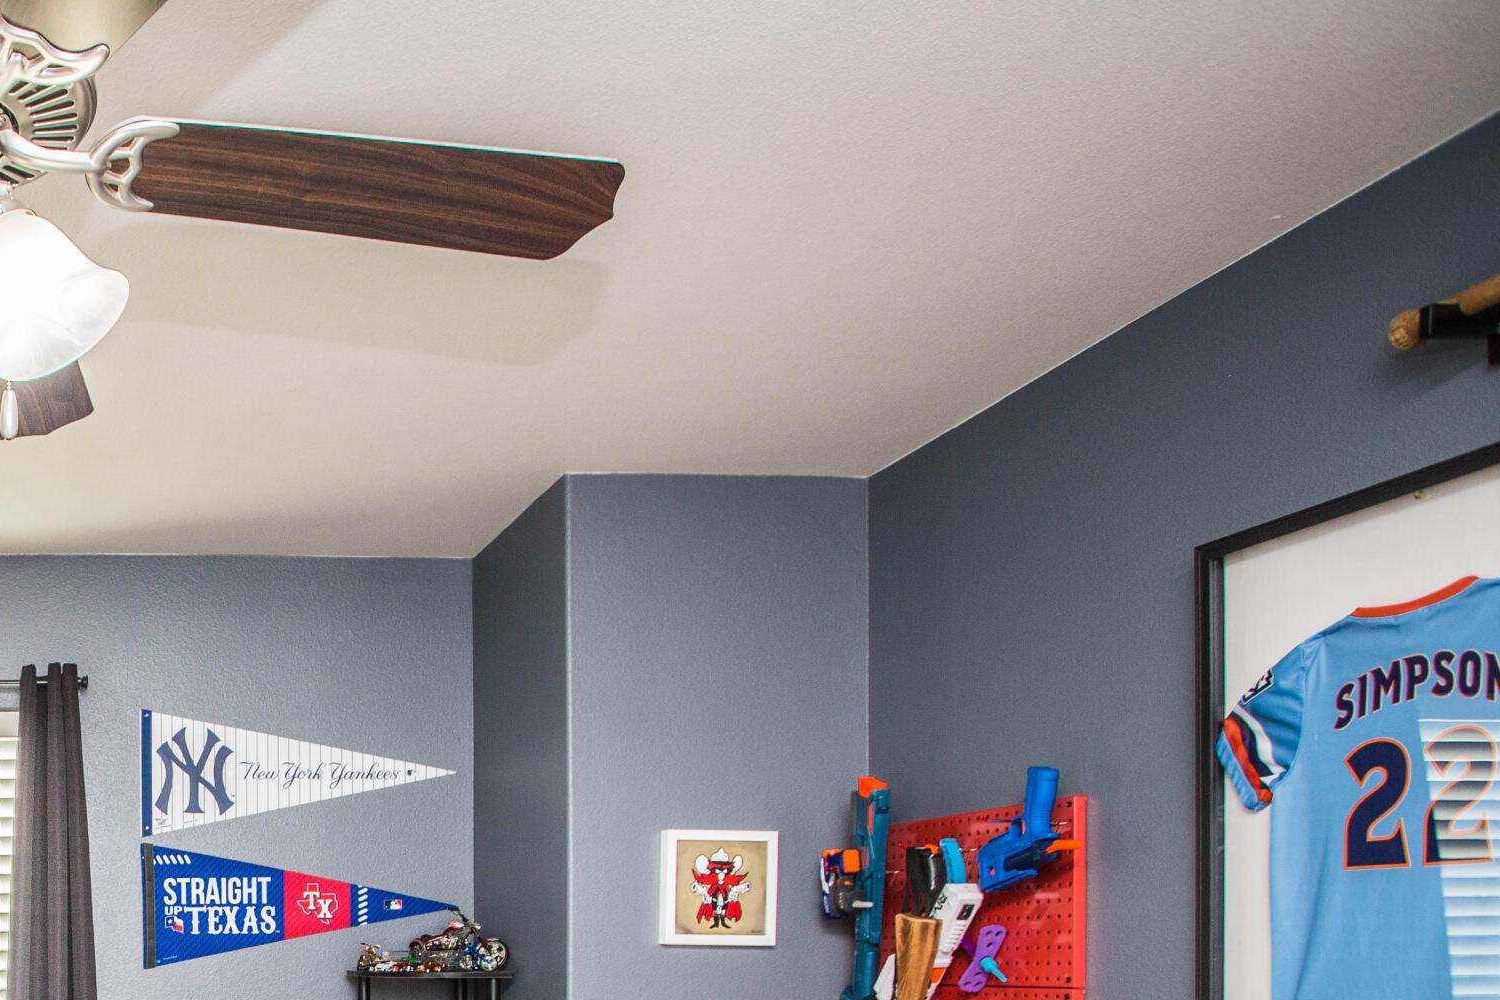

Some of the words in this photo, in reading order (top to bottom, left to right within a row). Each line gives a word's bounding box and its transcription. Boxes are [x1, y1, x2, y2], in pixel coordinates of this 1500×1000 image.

[1333, 650, 1500, 730] SIMPSON
[238, 761, 278, 780] New
[282, 761, 326, 789] York
[328, 761, 400, 789] Yankees
[1343, 724, 1497, 871] 22
[163, 876, 272, 905] STRAIGHT
[164, 905, 184, 916] UP
[184, 904, 276, 935] TEXAS
